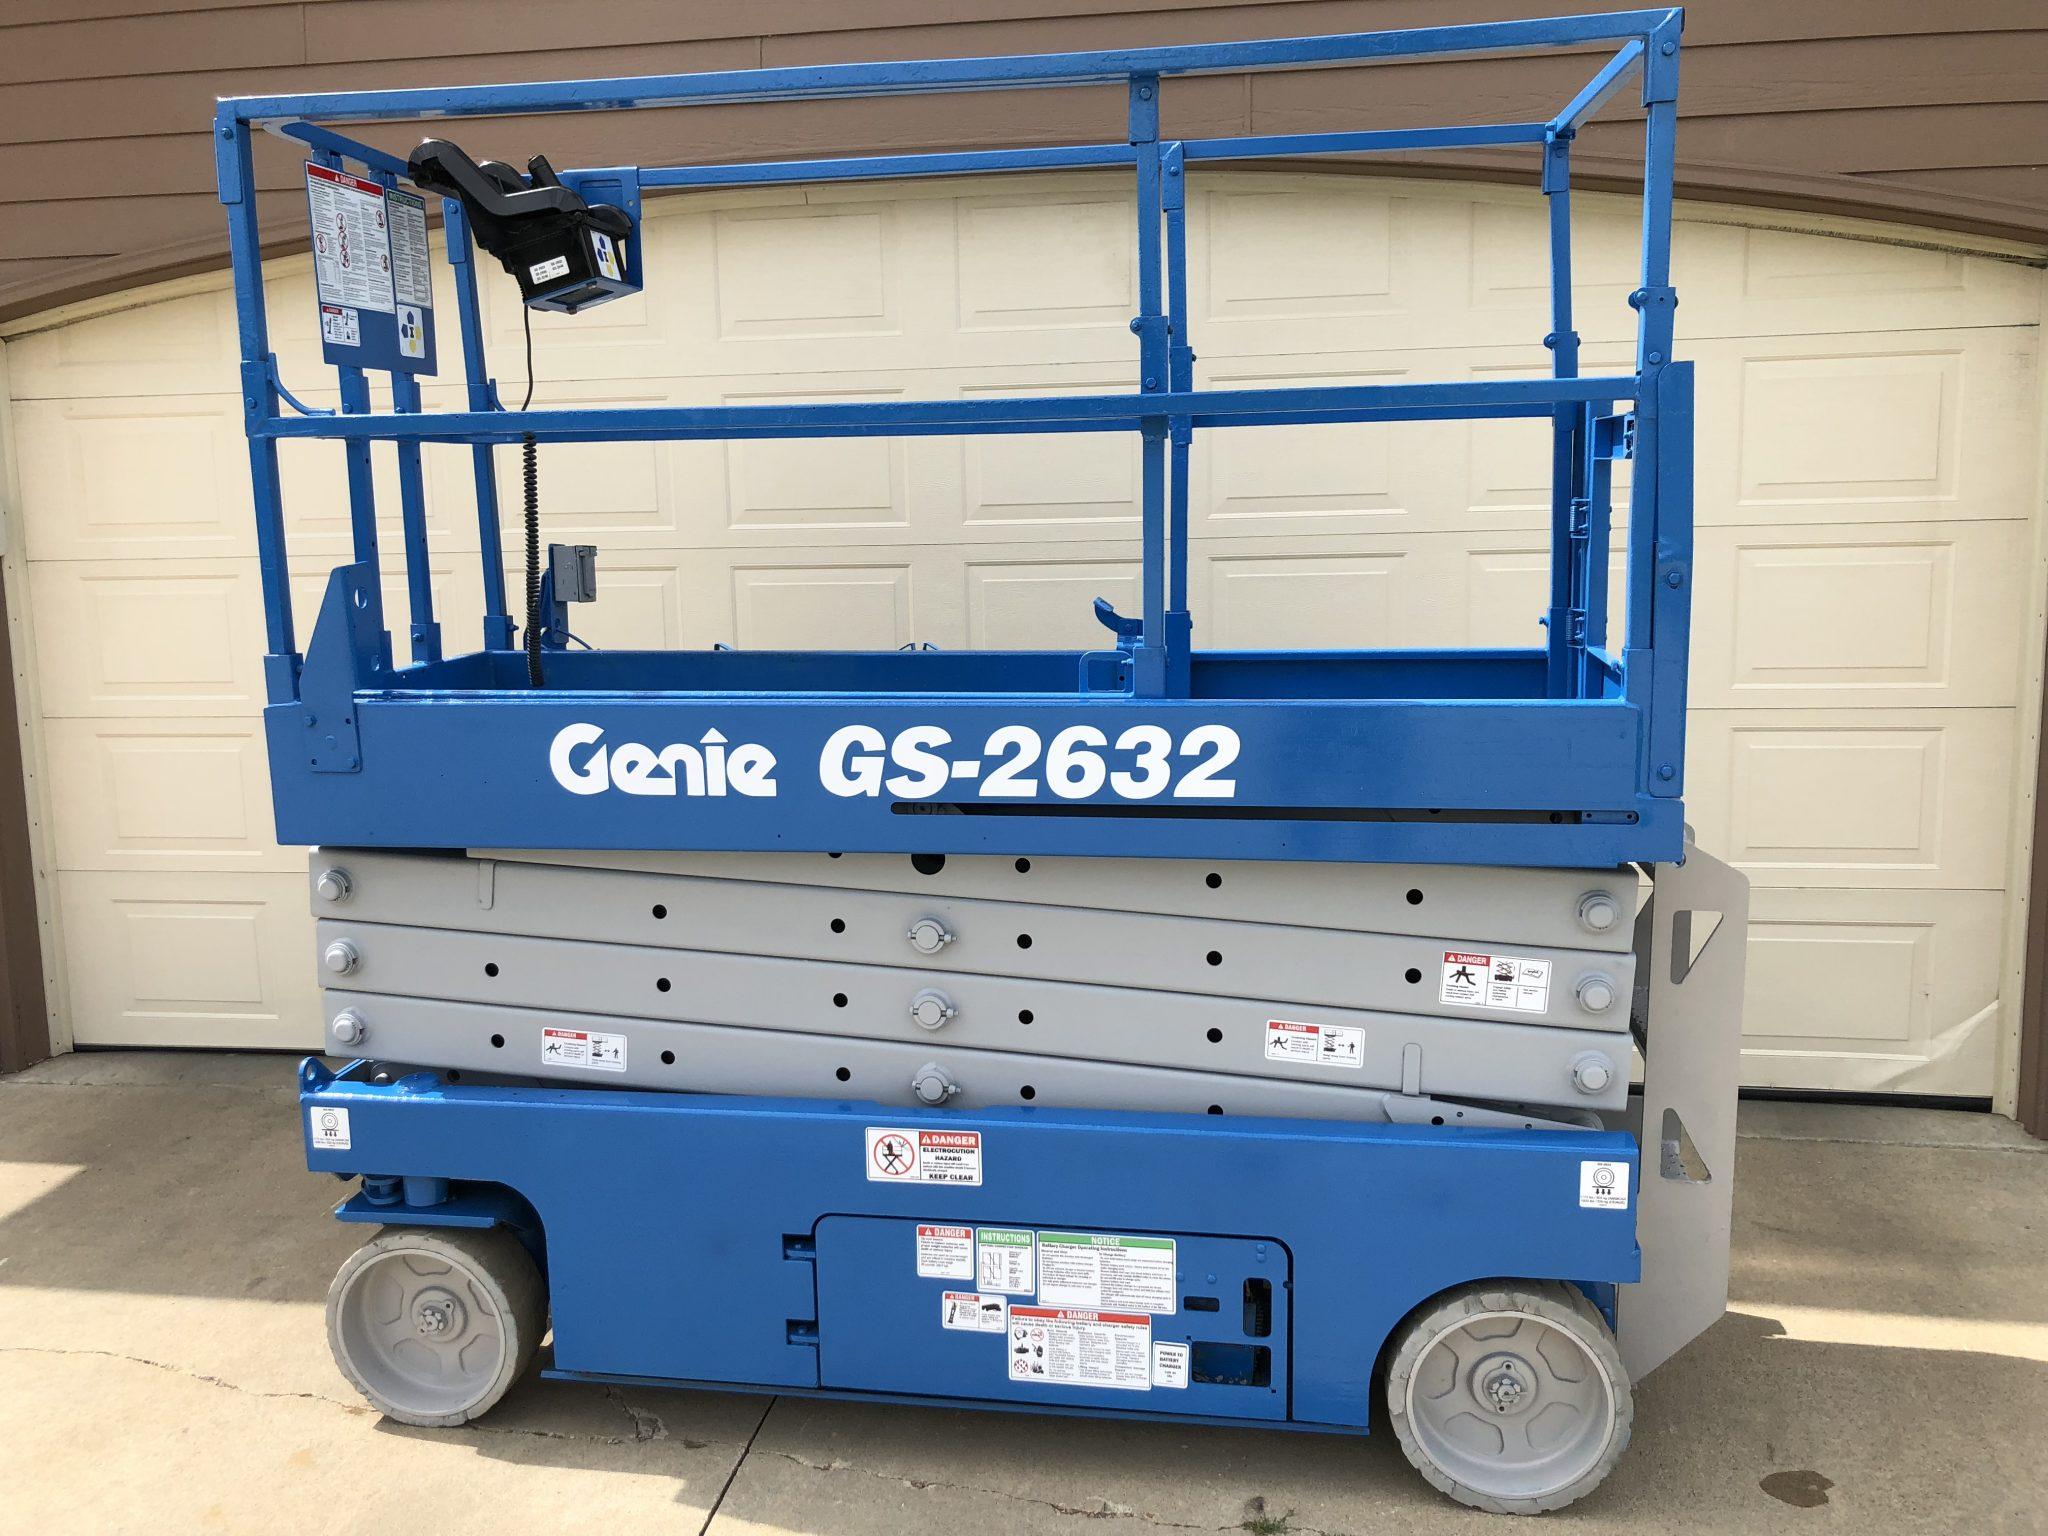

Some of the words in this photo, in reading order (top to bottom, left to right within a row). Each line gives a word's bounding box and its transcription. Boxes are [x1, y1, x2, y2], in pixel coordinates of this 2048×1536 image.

[340, 175, 357, 187] DANGER
[819, 724, 1241, 799] GS-2632
[1457, 955, 1486, 964] DANGER
[932, 1135, 976, 1145] DANGER
[935, 1228, 966, 1237] DANGER
[981, 1232, 1031, 1243] INSTRUCTIONS
[1091, 1237, 1120, 1245] NOTICE
[1067, 1311, 1099, 1320] DANGER
